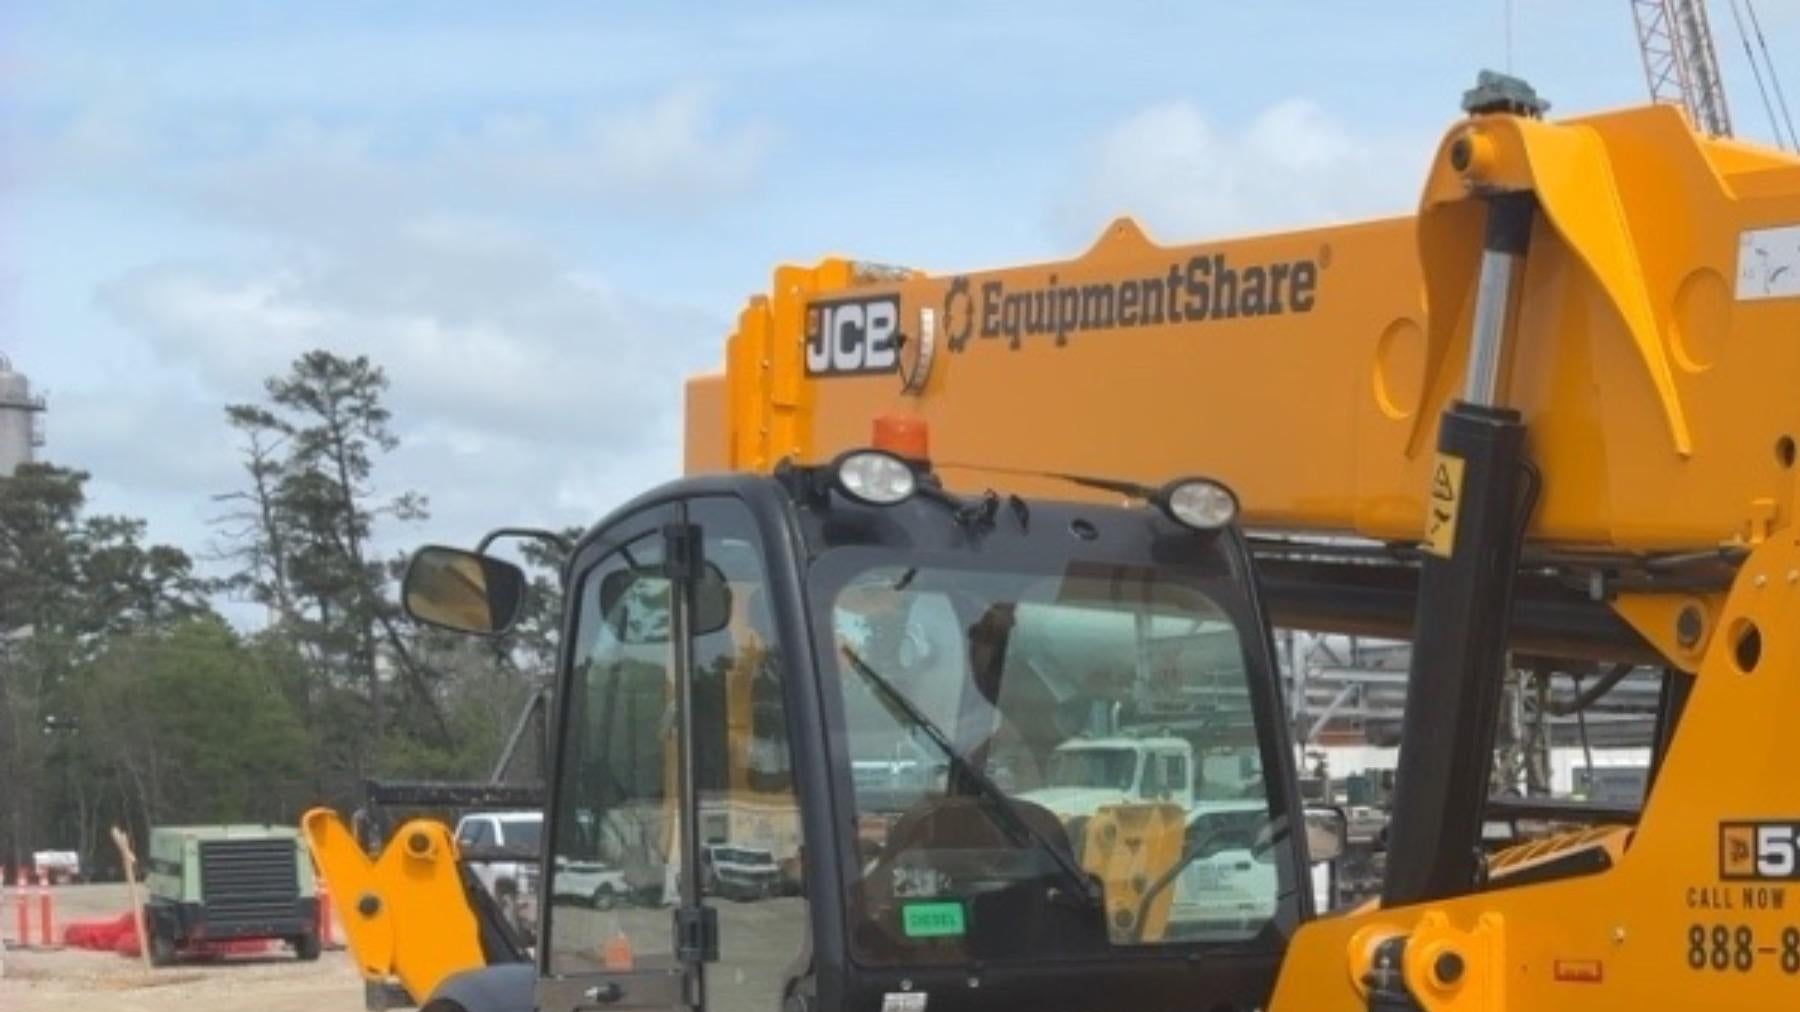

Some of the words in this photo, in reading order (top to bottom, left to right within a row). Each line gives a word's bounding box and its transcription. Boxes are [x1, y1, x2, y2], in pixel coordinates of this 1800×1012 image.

[807, 301, 897, 374] JCB
[979, 253, 1318, 350] EquipmentShare
[1686, 886, 1734, 909] CALL
[1742, 887, 1786, 909] NOW
